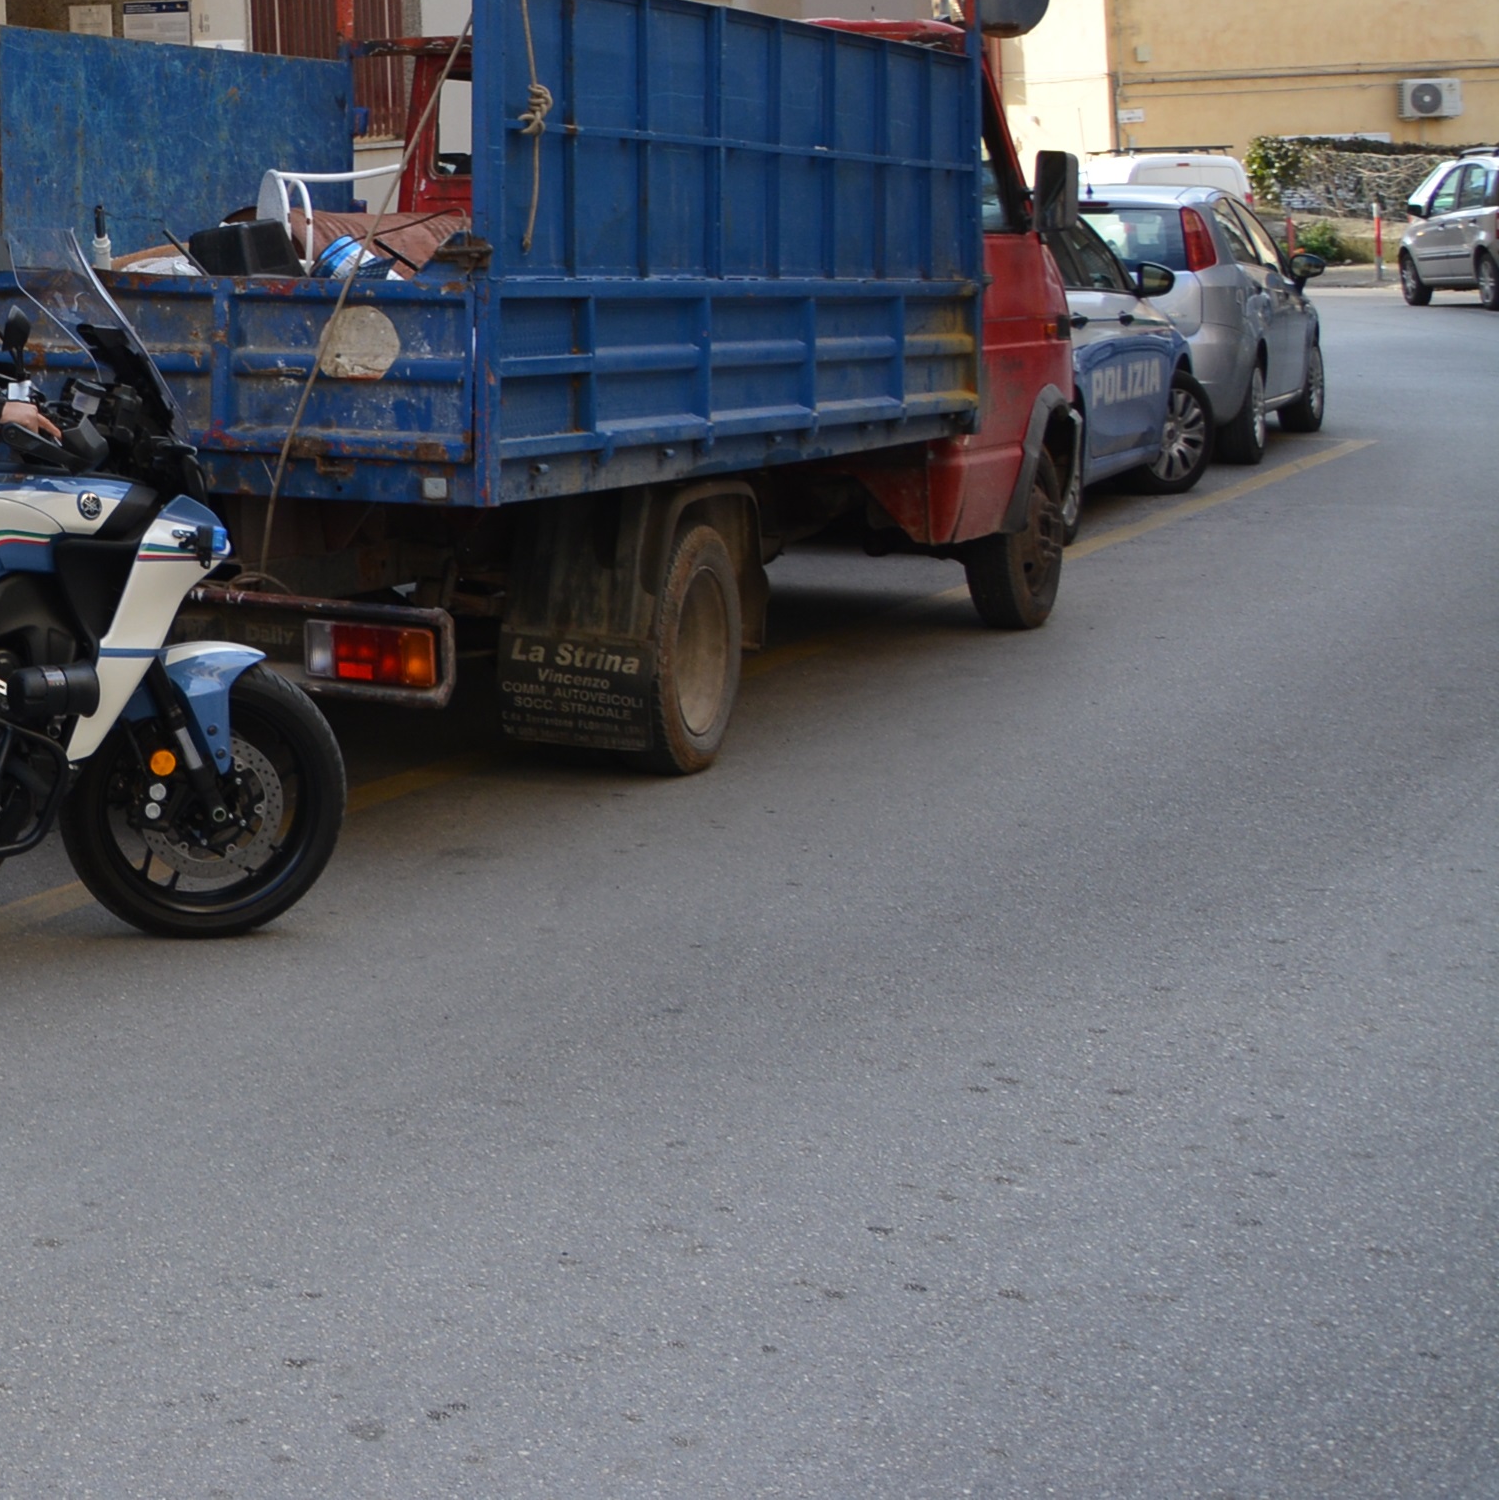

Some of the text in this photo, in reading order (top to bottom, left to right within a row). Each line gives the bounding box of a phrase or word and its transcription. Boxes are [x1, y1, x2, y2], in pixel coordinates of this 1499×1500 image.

[1091, 358, 1160, 409] POLIZIA
[511, 638, 640, 675] La Strina
[537, 667, 611, 689] Vincenzo
[513, 696, 632, 720] SOCC. STRADALE
[553, 687, 644, 708] AUTOVEICOLI
